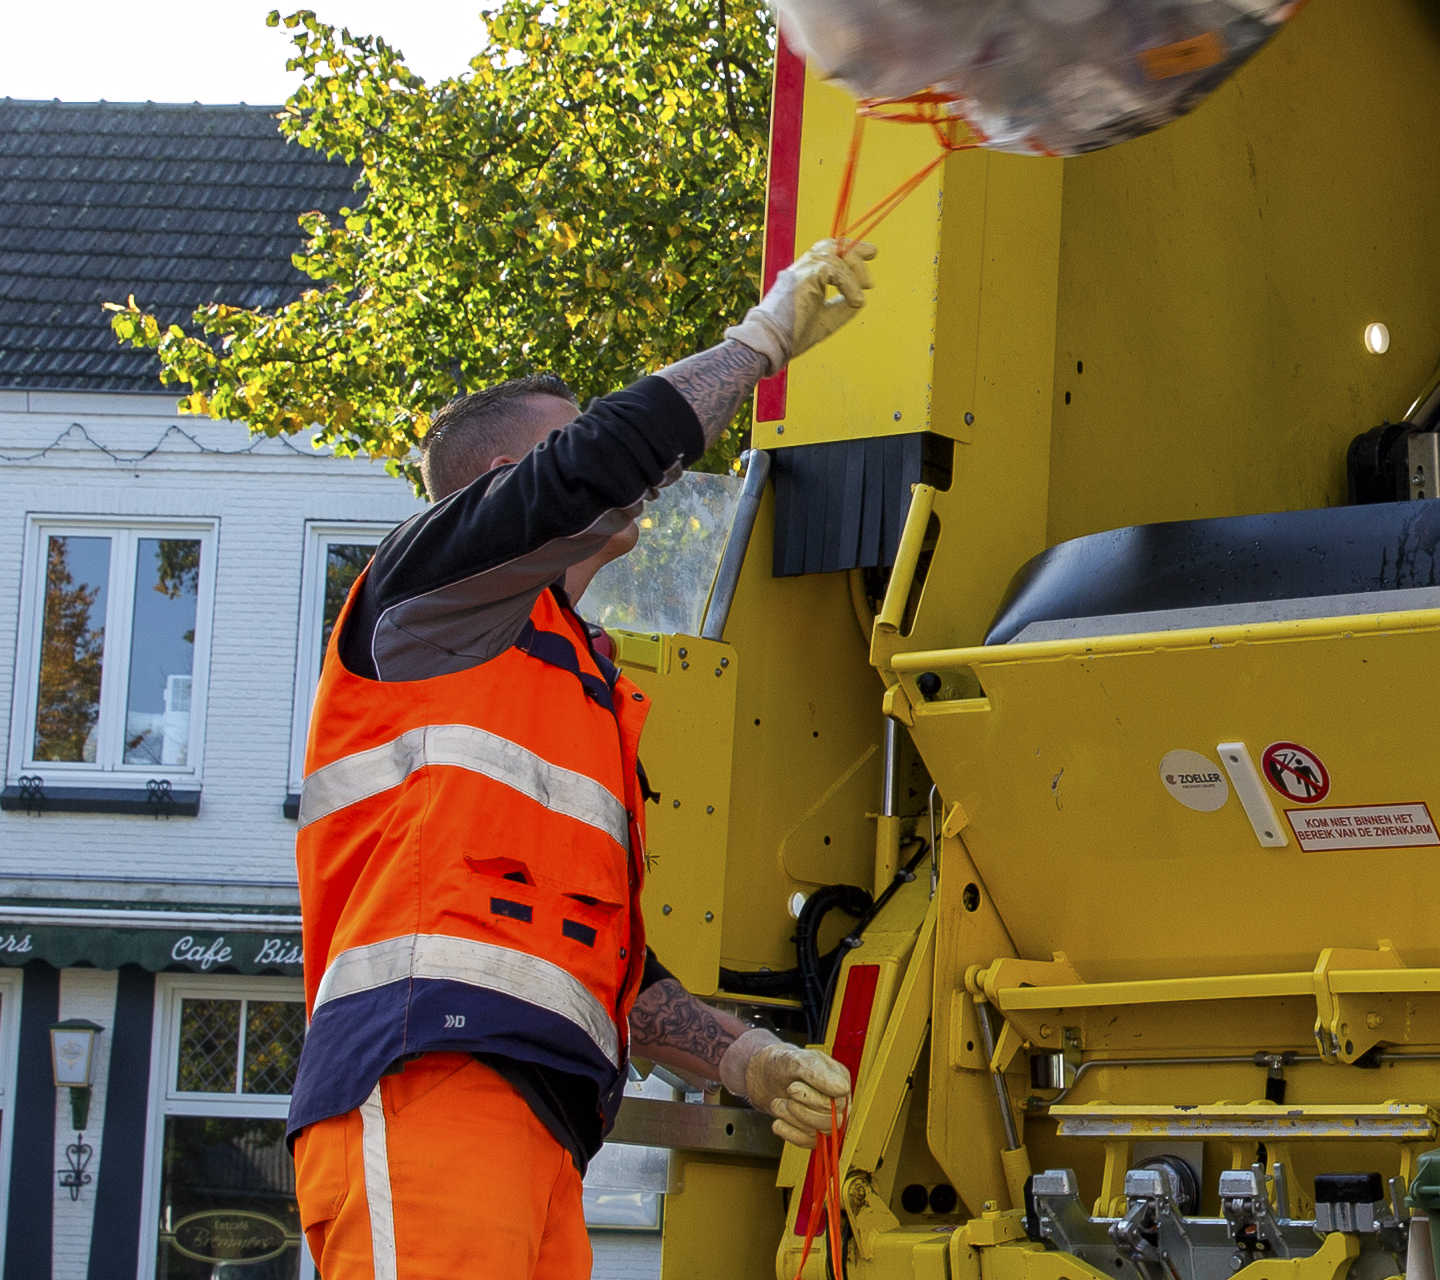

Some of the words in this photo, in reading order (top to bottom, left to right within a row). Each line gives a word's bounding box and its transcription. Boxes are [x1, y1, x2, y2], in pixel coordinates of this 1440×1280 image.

[1178, 773, 1222, 784] ZOELLER
[1304, 818, 1329, 829] KOM
[1329, 816, 1353, 828] NIET
[1353, 815, 1392, 826] BINNEN
[1393, 813, 1414, 824] HET
[1297, 829, 1336, 841] BEREIK
[1334, 828, 1357, 839] VAN
[1358, 827, 1375, 838] DE
[1373, 824, 1433, 838] ZWENKARM
[171, 935, 233, 969] Cafe
